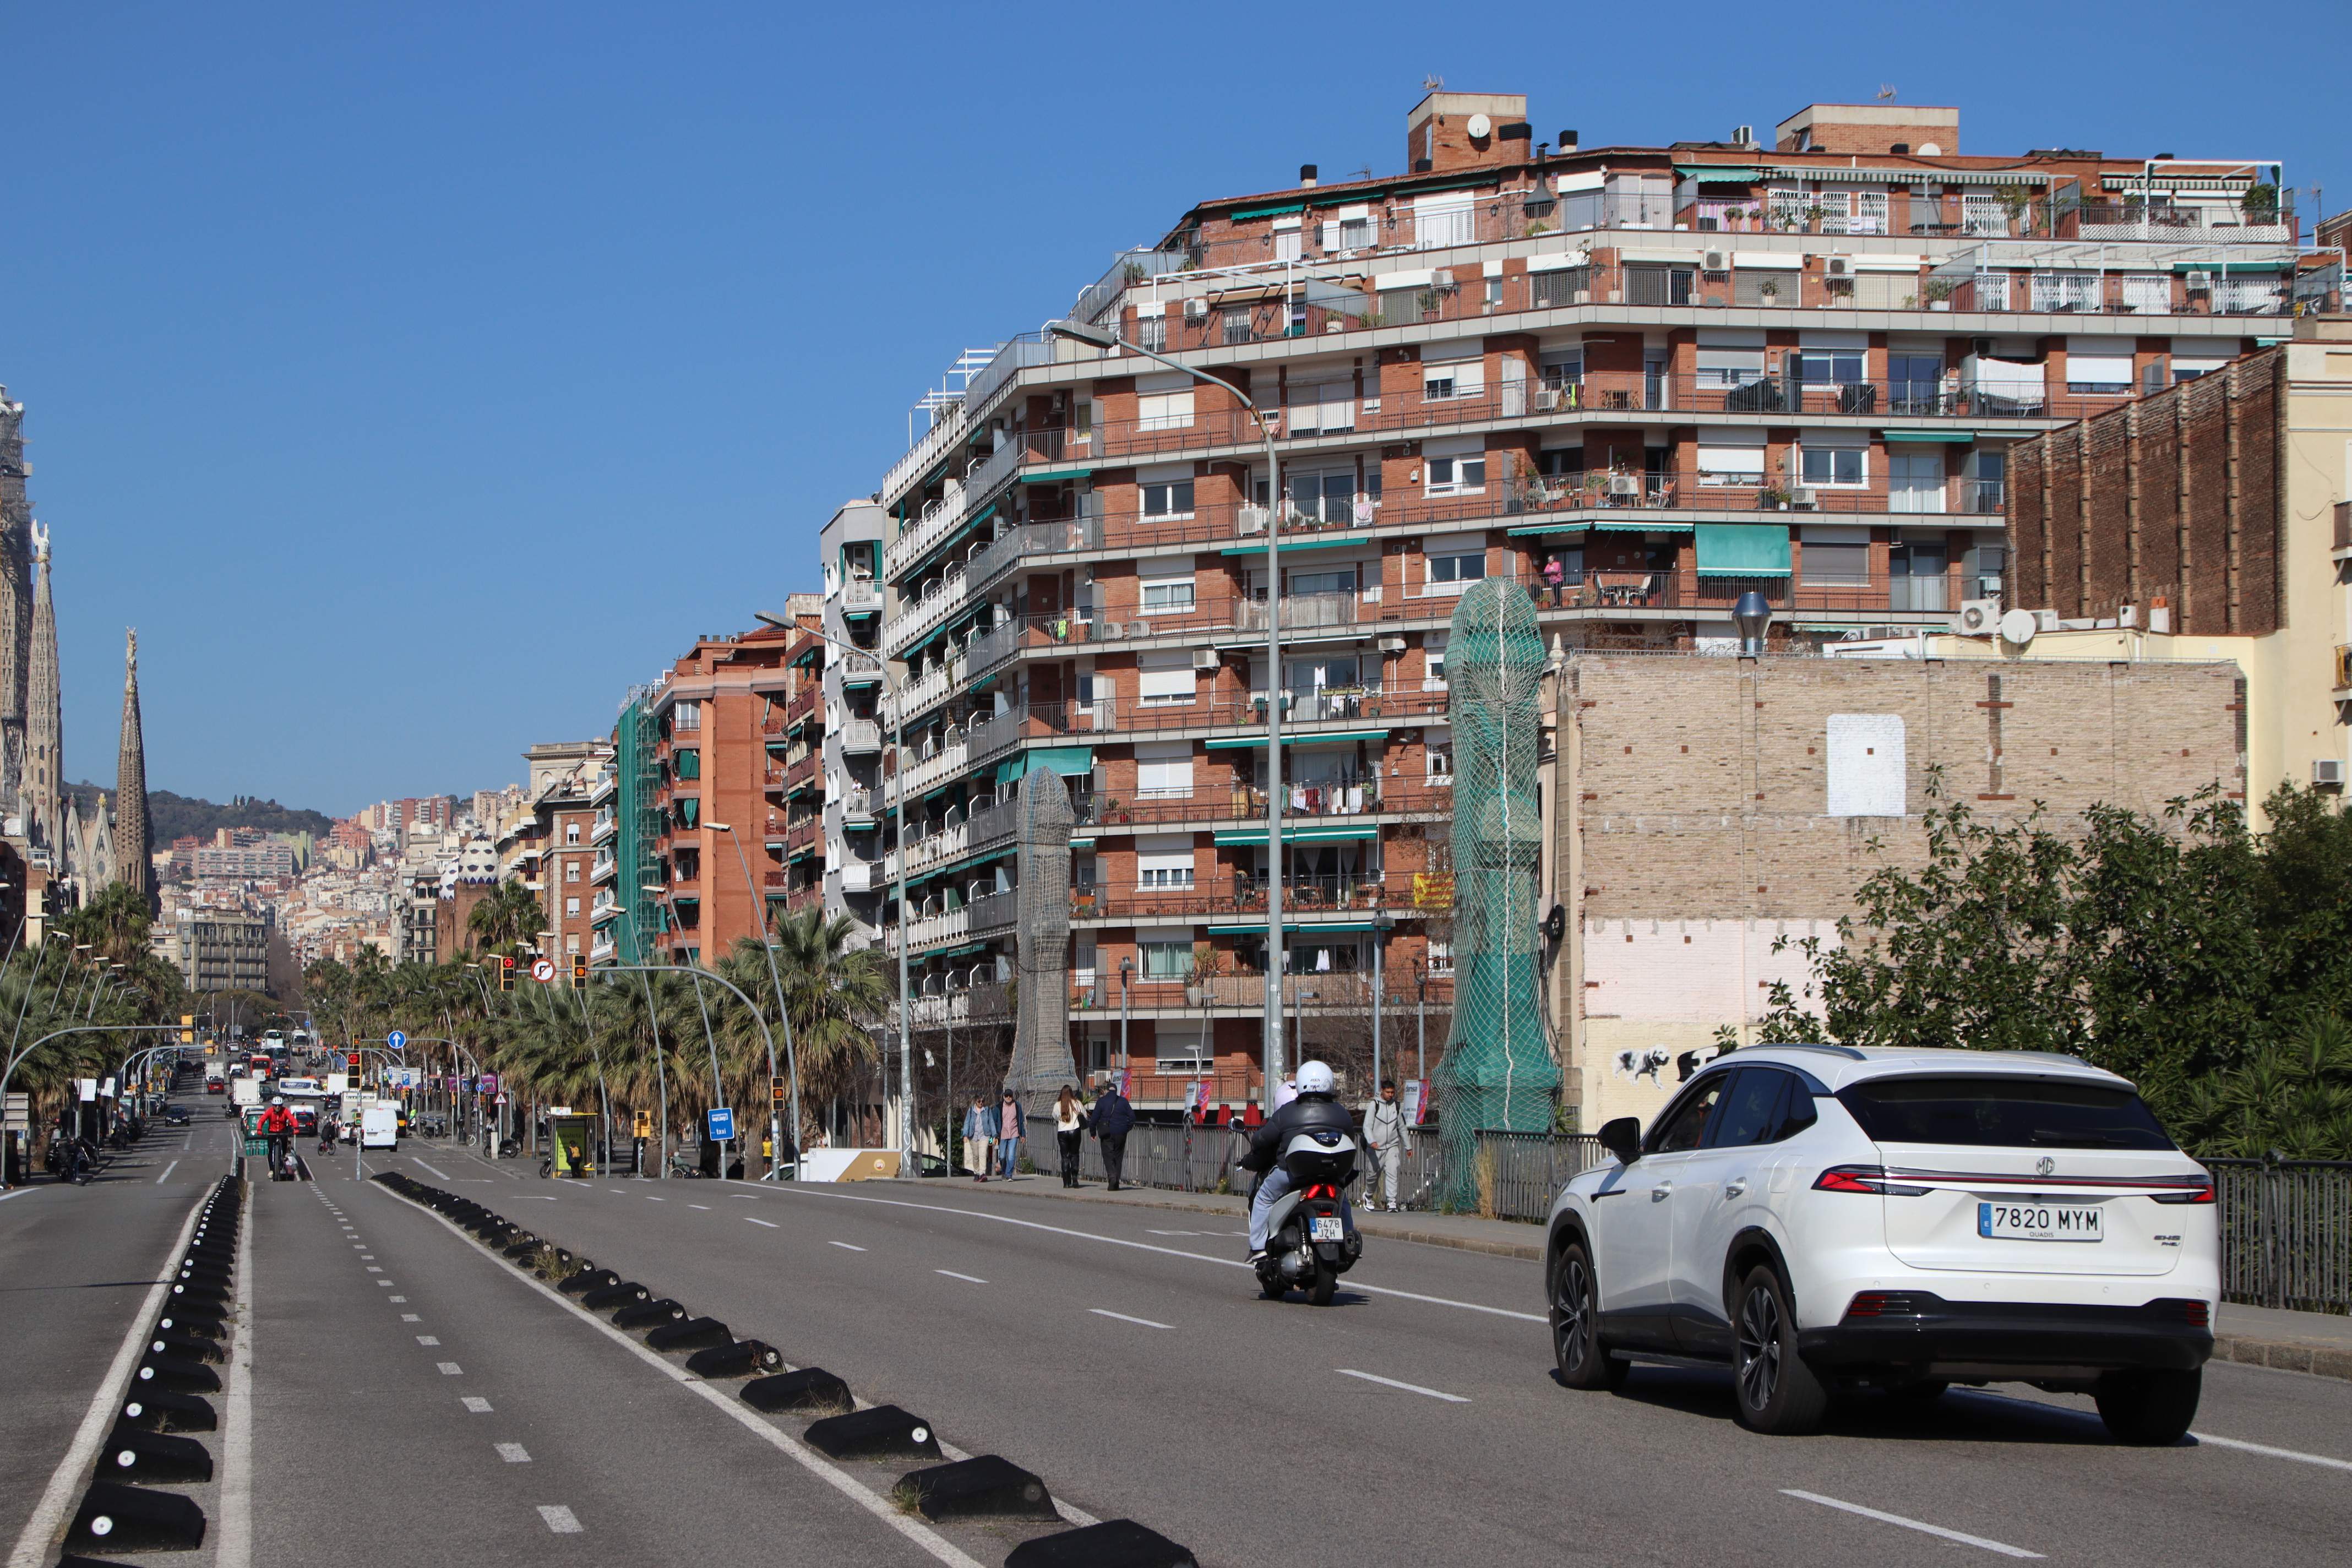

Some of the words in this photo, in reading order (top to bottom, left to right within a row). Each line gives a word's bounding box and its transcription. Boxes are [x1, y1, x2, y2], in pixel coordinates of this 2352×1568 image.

[2037, 1157, 2055, 1175] MG
[1317, 1220, 1340, 1228] 6478
[1996, 1207, 2049, 1228] 7820
[2059, 1210, 2098, 1231] MYM
[1319, 1229, 1335, 1238] JZH
